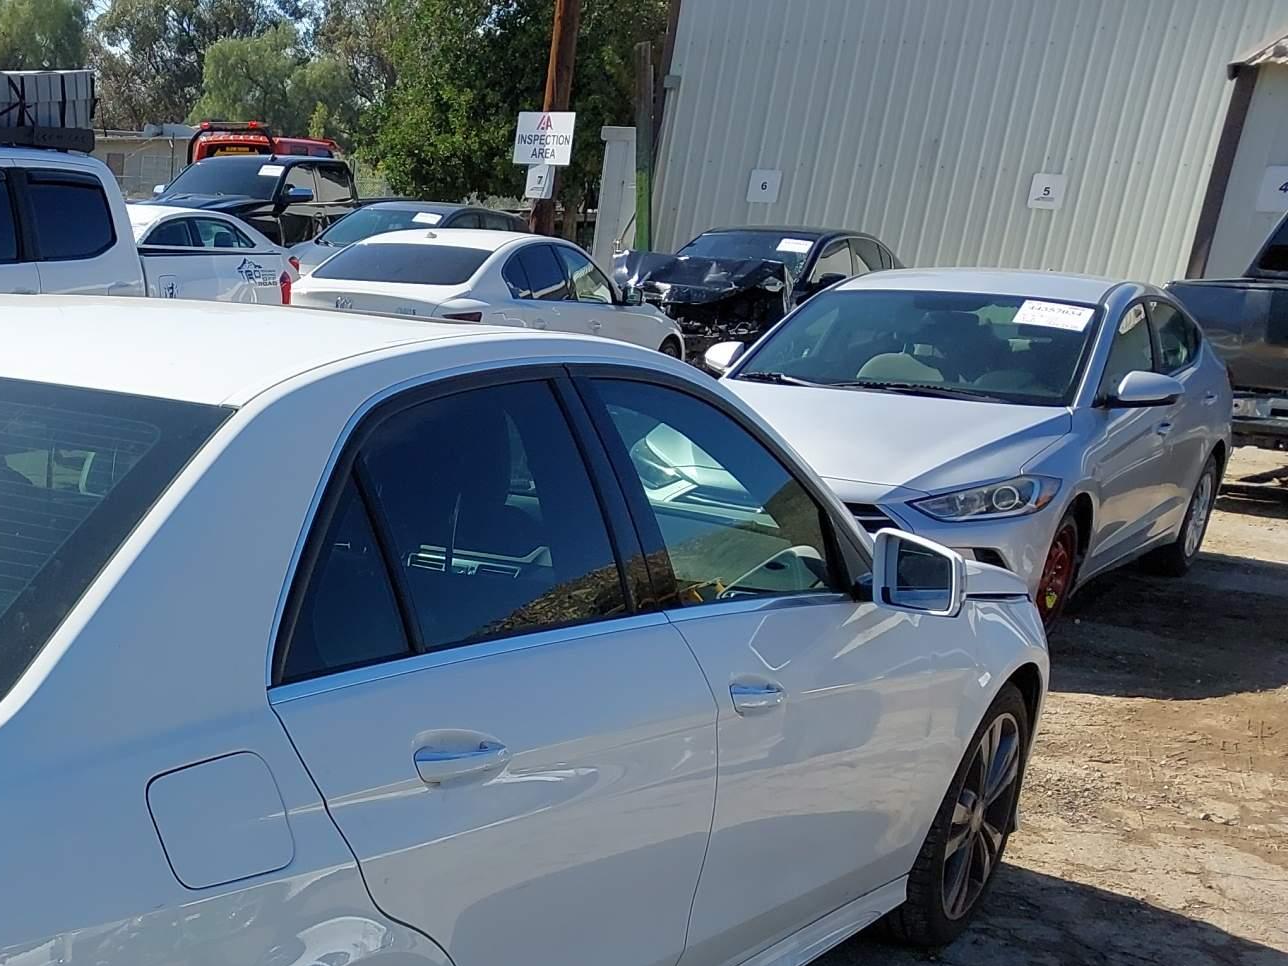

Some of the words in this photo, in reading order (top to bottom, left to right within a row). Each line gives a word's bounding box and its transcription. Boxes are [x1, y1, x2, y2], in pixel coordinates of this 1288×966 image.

[517, 133, 571, 145] INSPECTION
[530, 148, 555, 159] AREA
[537, 176, 543, 184] 7
[760, 181, 768, 190] 6
[1042, 186, 1051, 196] 5
